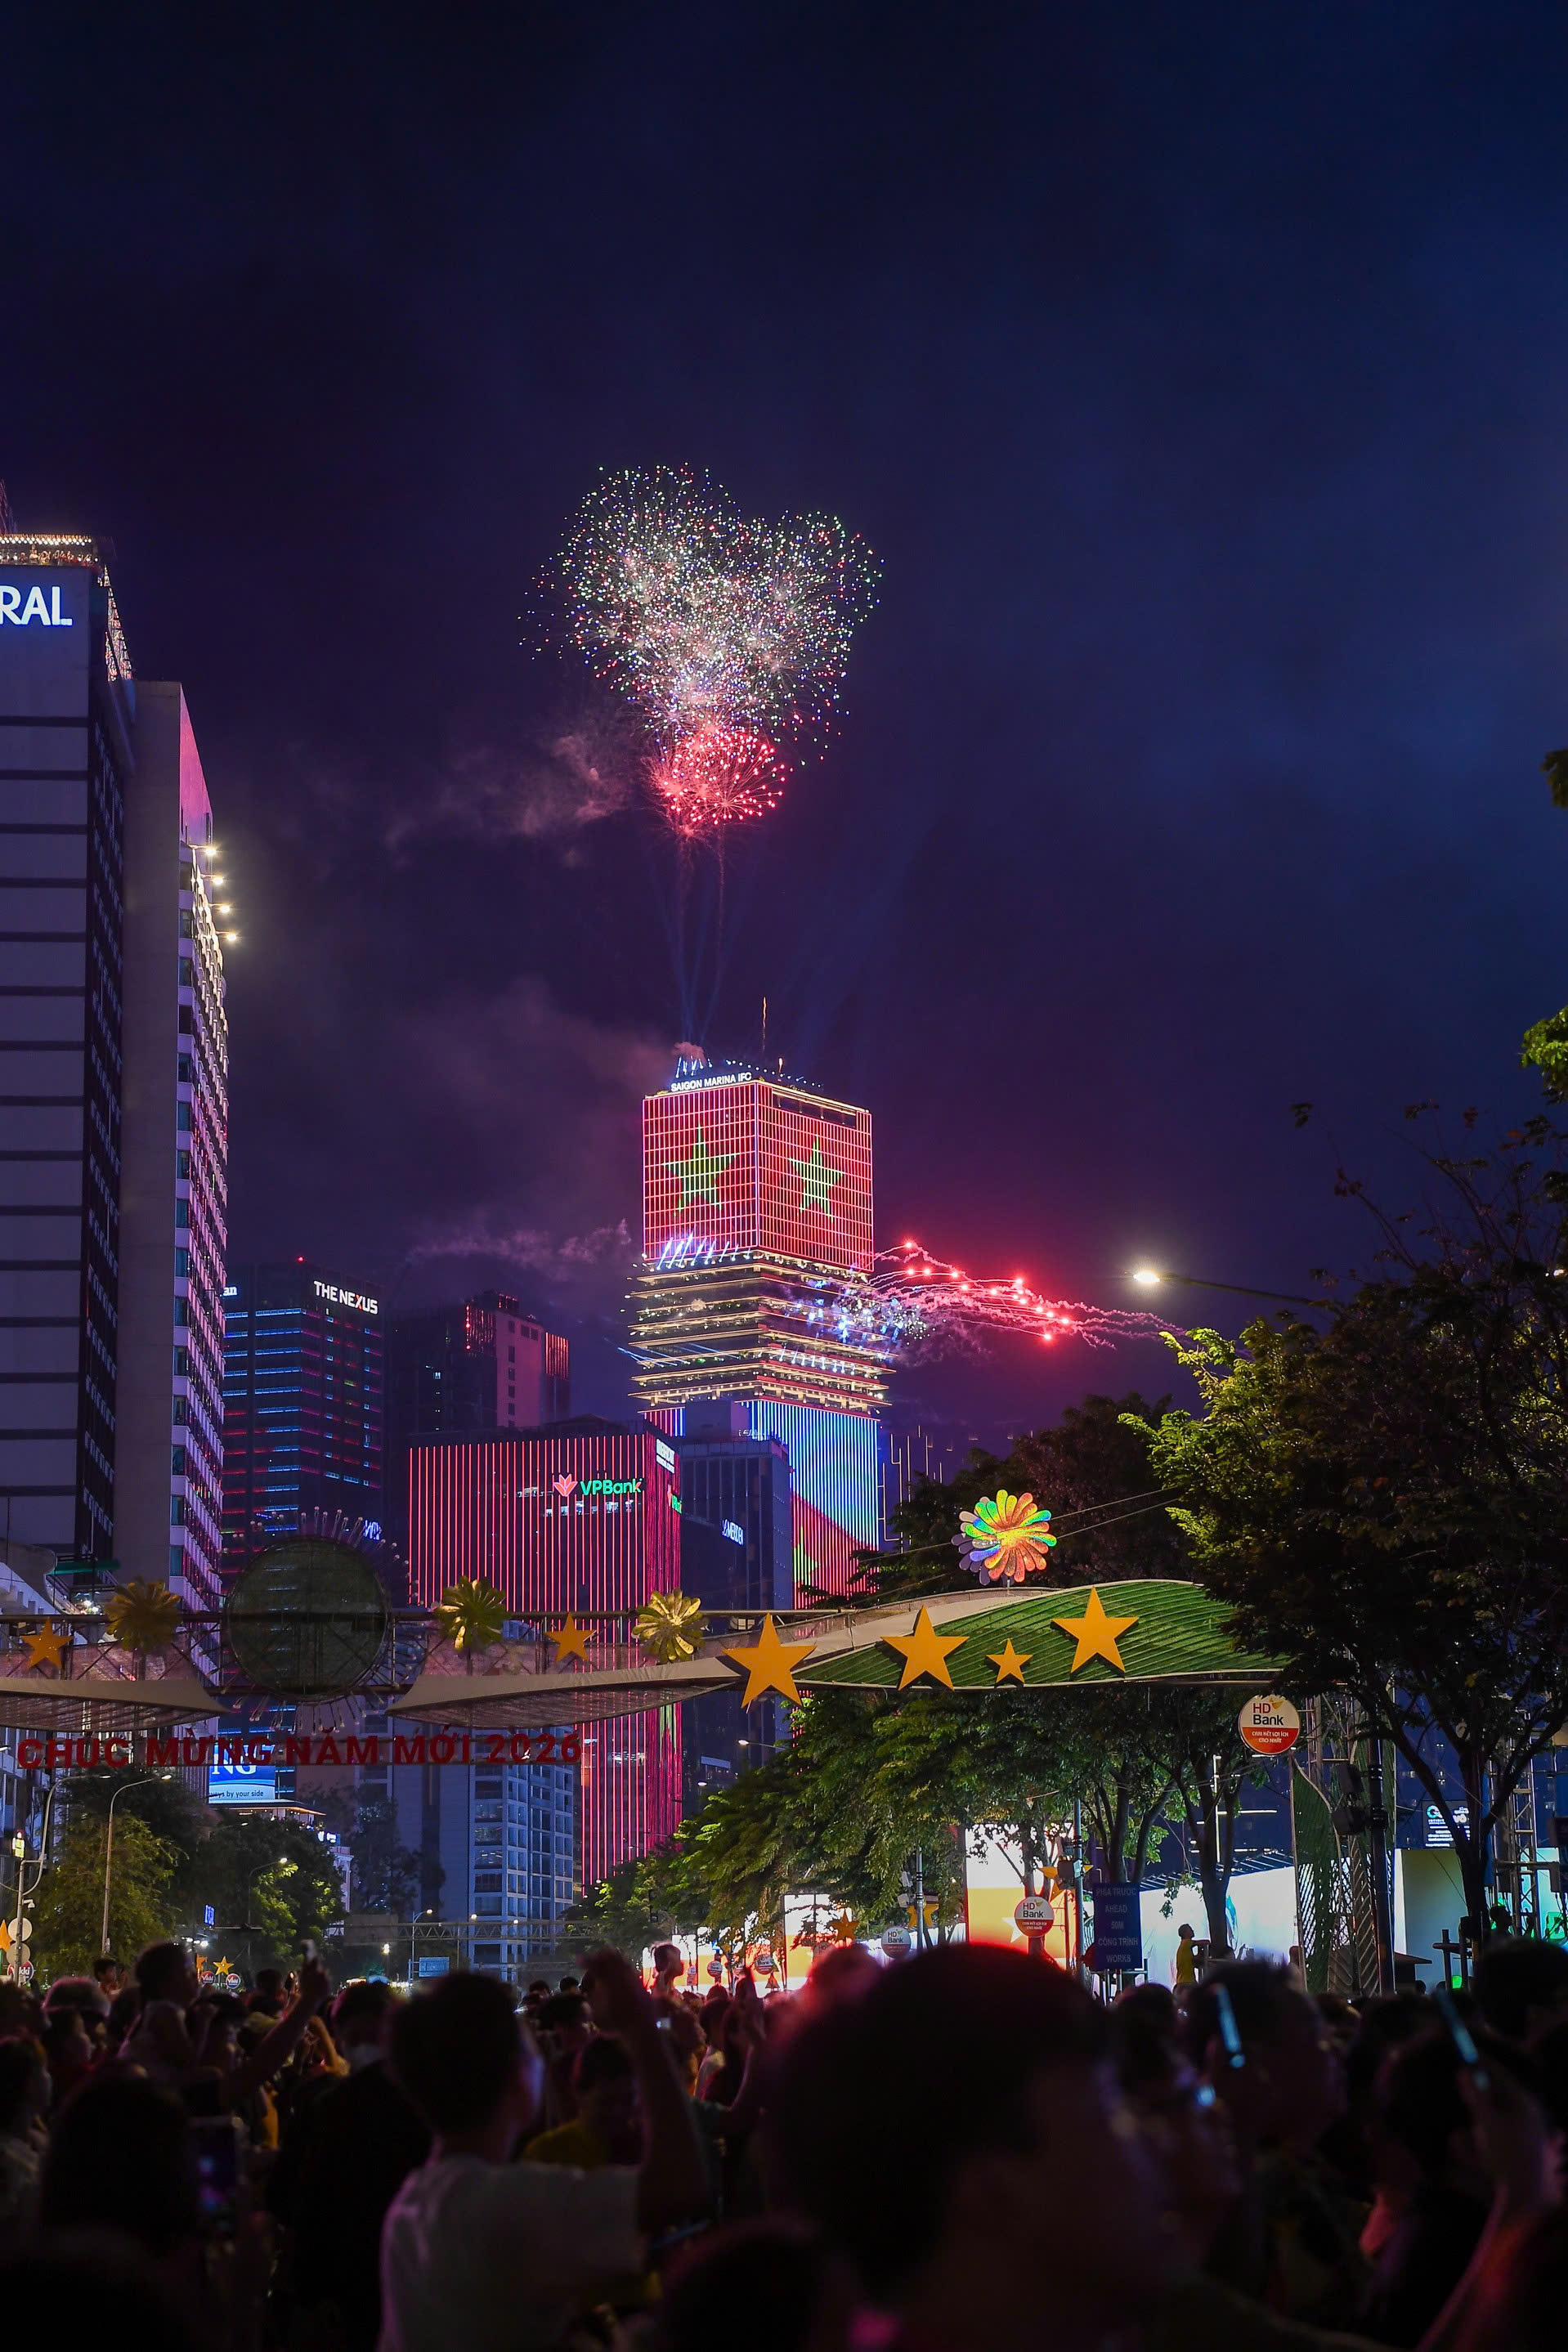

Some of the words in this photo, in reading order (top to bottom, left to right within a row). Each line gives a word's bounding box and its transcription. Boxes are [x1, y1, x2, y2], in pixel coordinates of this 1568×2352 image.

[0, 585, 73, 625] RAL
[670, 1079, 702, 1092] SAIGON
[704, 1074, 736, 1087] MARINA
[738, 1072, 752, 1082] IFC
[220, 1285, 237, 1297] an
[314, 1280, 338, 1302] THE
[339, 1290, 379, 1315] NEXUS
[580, 1478, 643, 1496] VPBank
[1253, 1703, 1271, 1714] HD
[1253, 1714, 1284, 1725] Bank
[285, 1727, 379, 1765] NĂM
[486, 1732, 582, 1764] 2026
[226, 1790, 234, 1799] by
[1105, 1904, 1127, 1913] AHEAD
[1098, 1937, 1117, 1946] CÔNG
[1118, 1935, 1138, 1946] TRÌNH
[1106, 1955, 1131, 1963] WORKS
